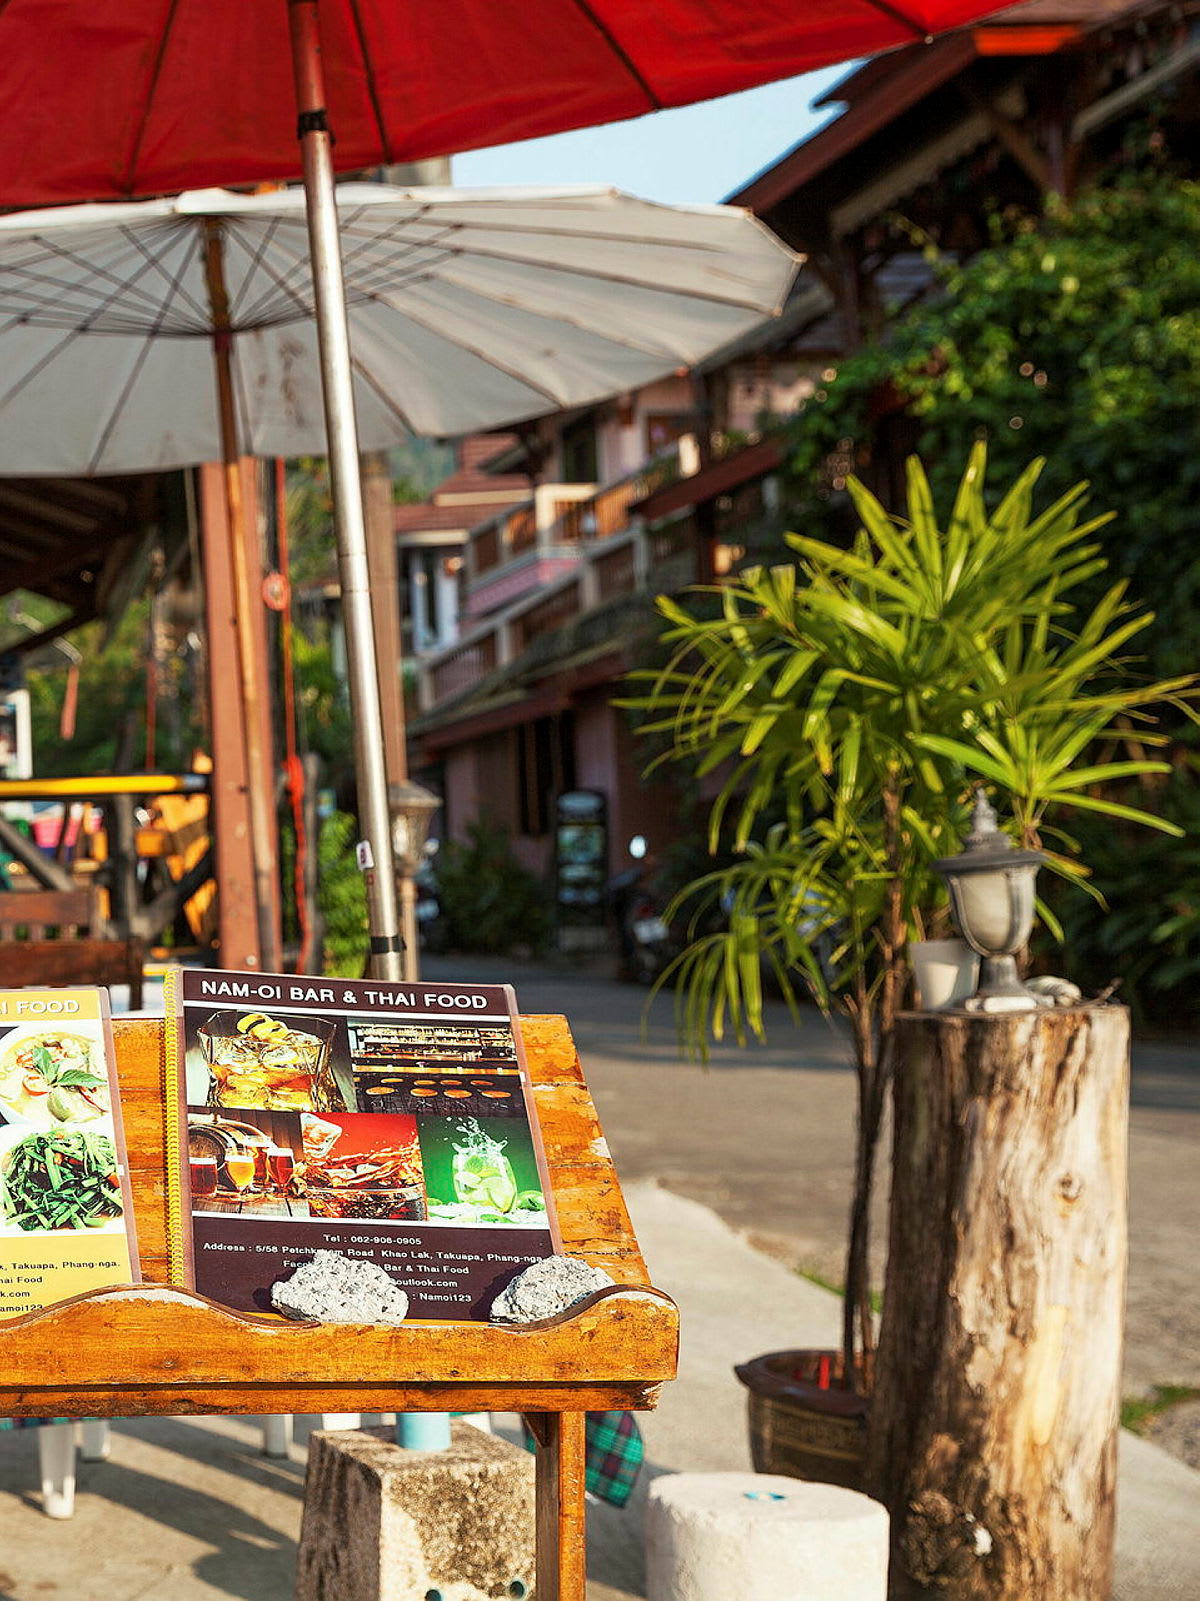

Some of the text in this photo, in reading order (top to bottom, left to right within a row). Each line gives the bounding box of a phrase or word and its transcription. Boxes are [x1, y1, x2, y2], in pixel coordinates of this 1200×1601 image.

[202, 980, 487, 1009] NAM-OI BAR & THAI FOOD
[16, 1000, 80, 1014] FOOD
[323, 1234, 341, 1242] Tel
[203, 1242, 245, 1252] Address
[255, 1245, 278, 1253] 5/58
[282, 1246, 344, 1256] Petchkm
[347, 1249, 374, 1257] Road
[381, 1250, 408, 1258] Khao
[410, 1251, 433, 1260] Lak,
[436, 1252, 484, 1262] Takuapa,
[12, 1262, 58, 1271] Takuapa,
[62, 1261, 121, 1269] Phang-nga.
[384, 1264, 402, 1272] Bar
[405, 1264, 413, 1272] &
[416, 1265, 440, 1273] Thai
[443, 1266, 470, 1274] Food
[17, 1276, 43, 1284] Food
